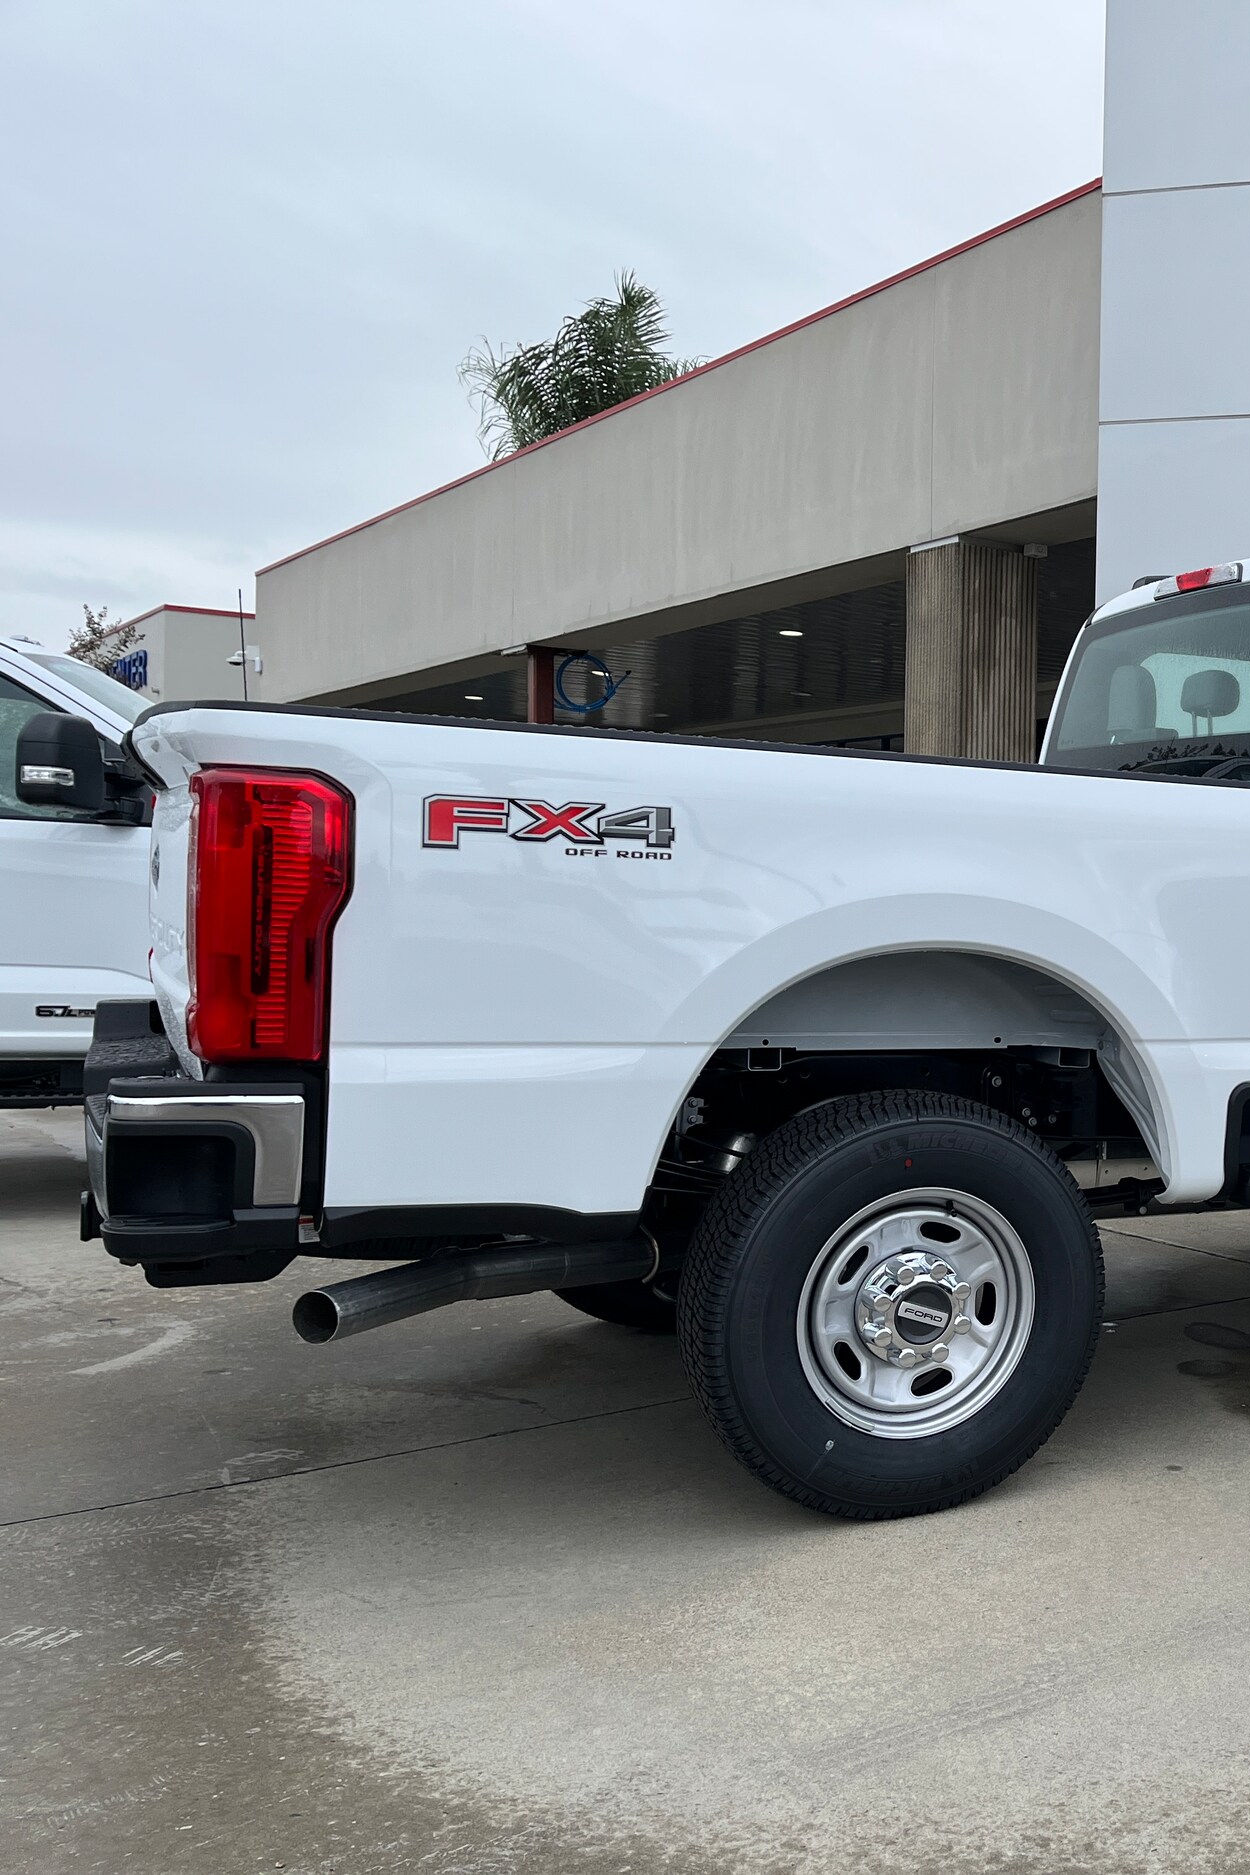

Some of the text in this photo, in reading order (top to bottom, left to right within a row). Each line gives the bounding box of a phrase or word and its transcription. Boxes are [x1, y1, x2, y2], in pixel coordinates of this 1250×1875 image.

[422, 794, 675, 849] FX4
[565, 848, 672, 860] OFF ROAD
[254, 855, 264, 976] SUPER DUTY
[904, 1307, 943, 1323] FORD
